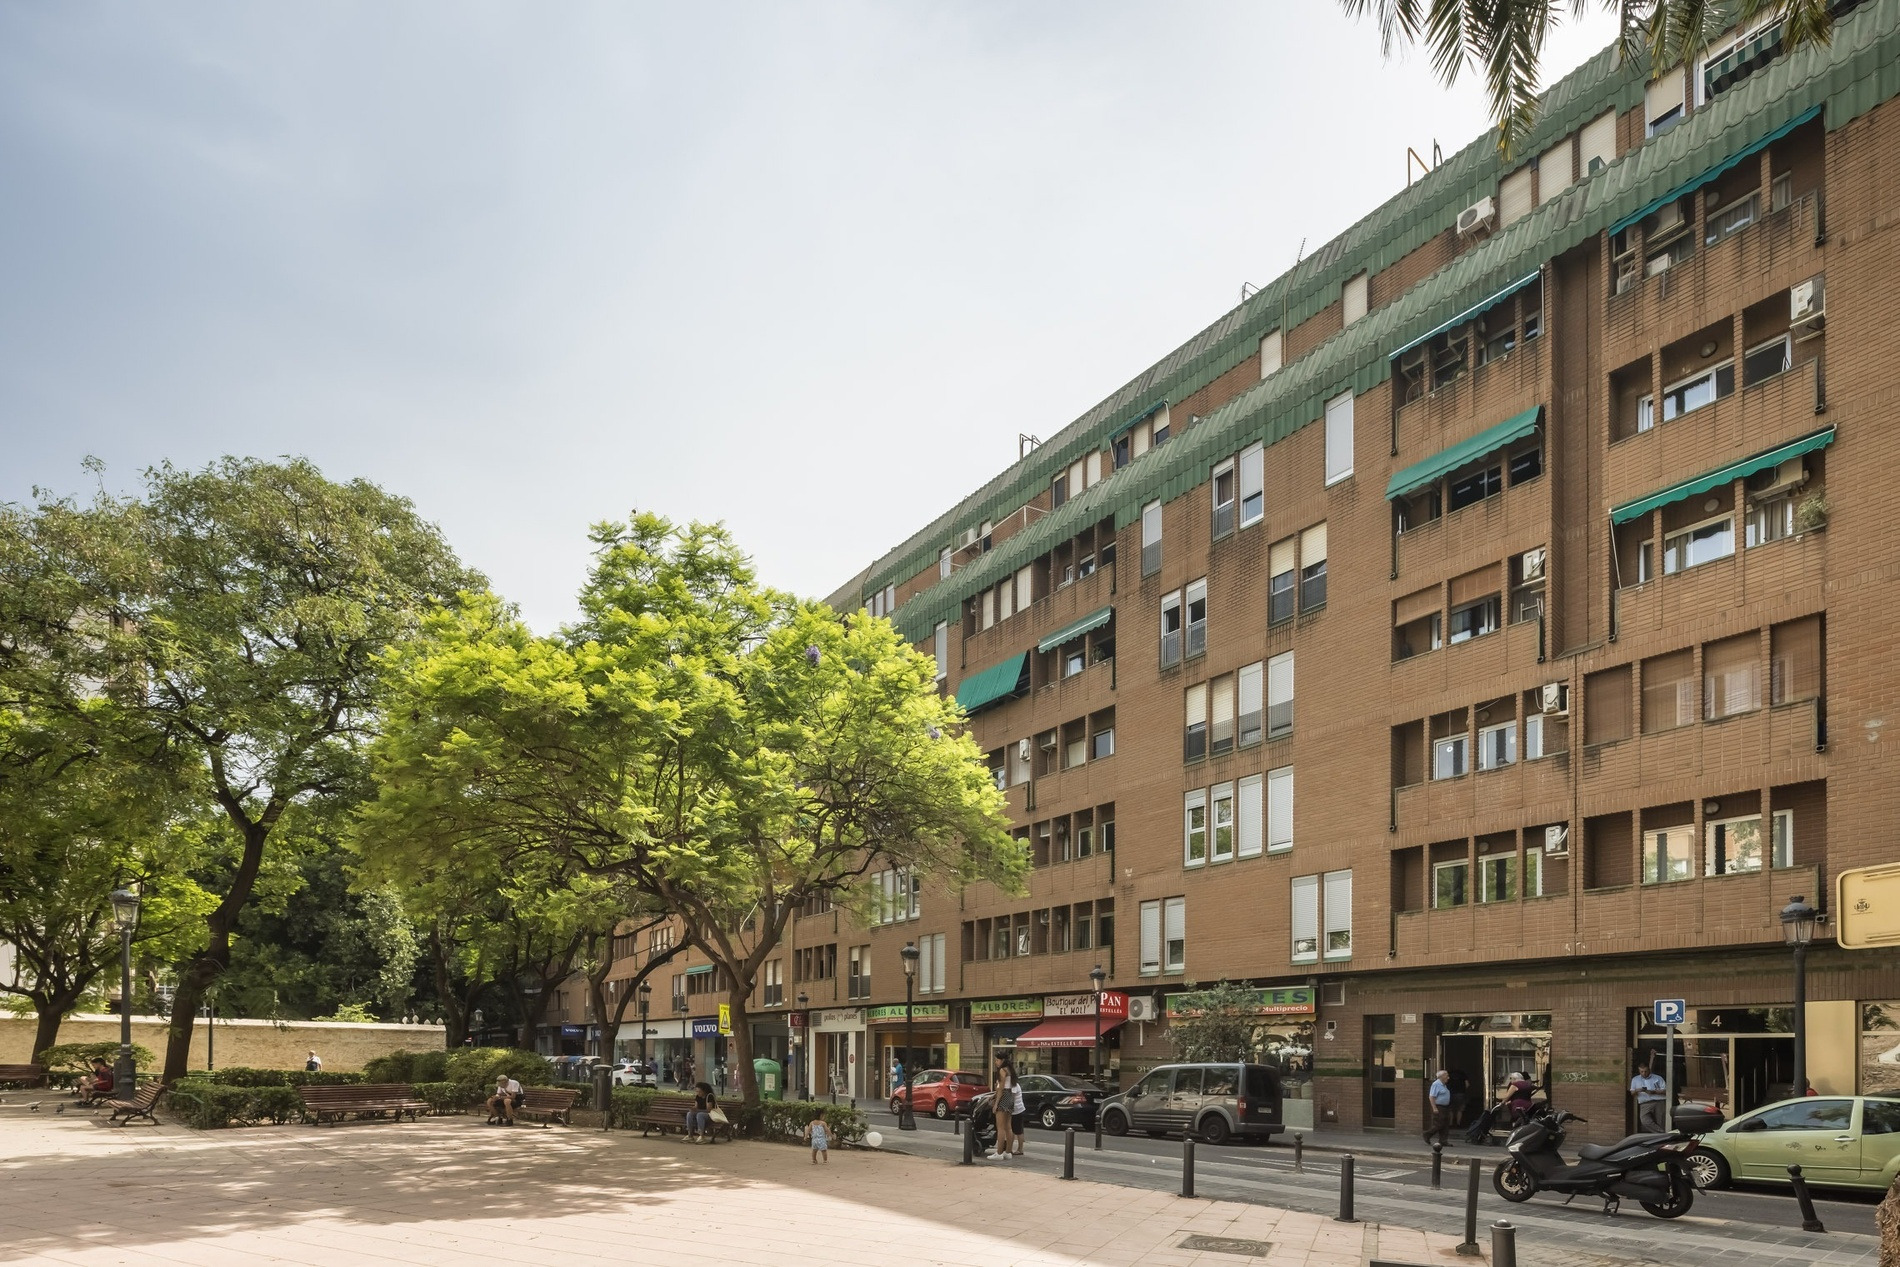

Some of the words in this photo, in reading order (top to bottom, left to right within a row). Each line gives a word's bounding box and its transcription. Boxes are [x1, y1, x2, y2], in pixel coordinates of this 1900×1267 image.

[1046, 997, 1077, 1008] Boutique
[1078, 995, 1089, 1005] del
[1100, 991, 1122, 1007] PAN
[889, 1006, 945, 1016] ALORES
[980, 1002, 1032, 1012] ALBORES
[1262, 1005, 1308, 1014] Multiprecio
[1660, 1002, 1679, 1021] P
[867, 1008, 887, 1018] ALBORES
[1711, 1014, 1722, 1027] 4
[694, 1024, 718, 1033] VOLVO
